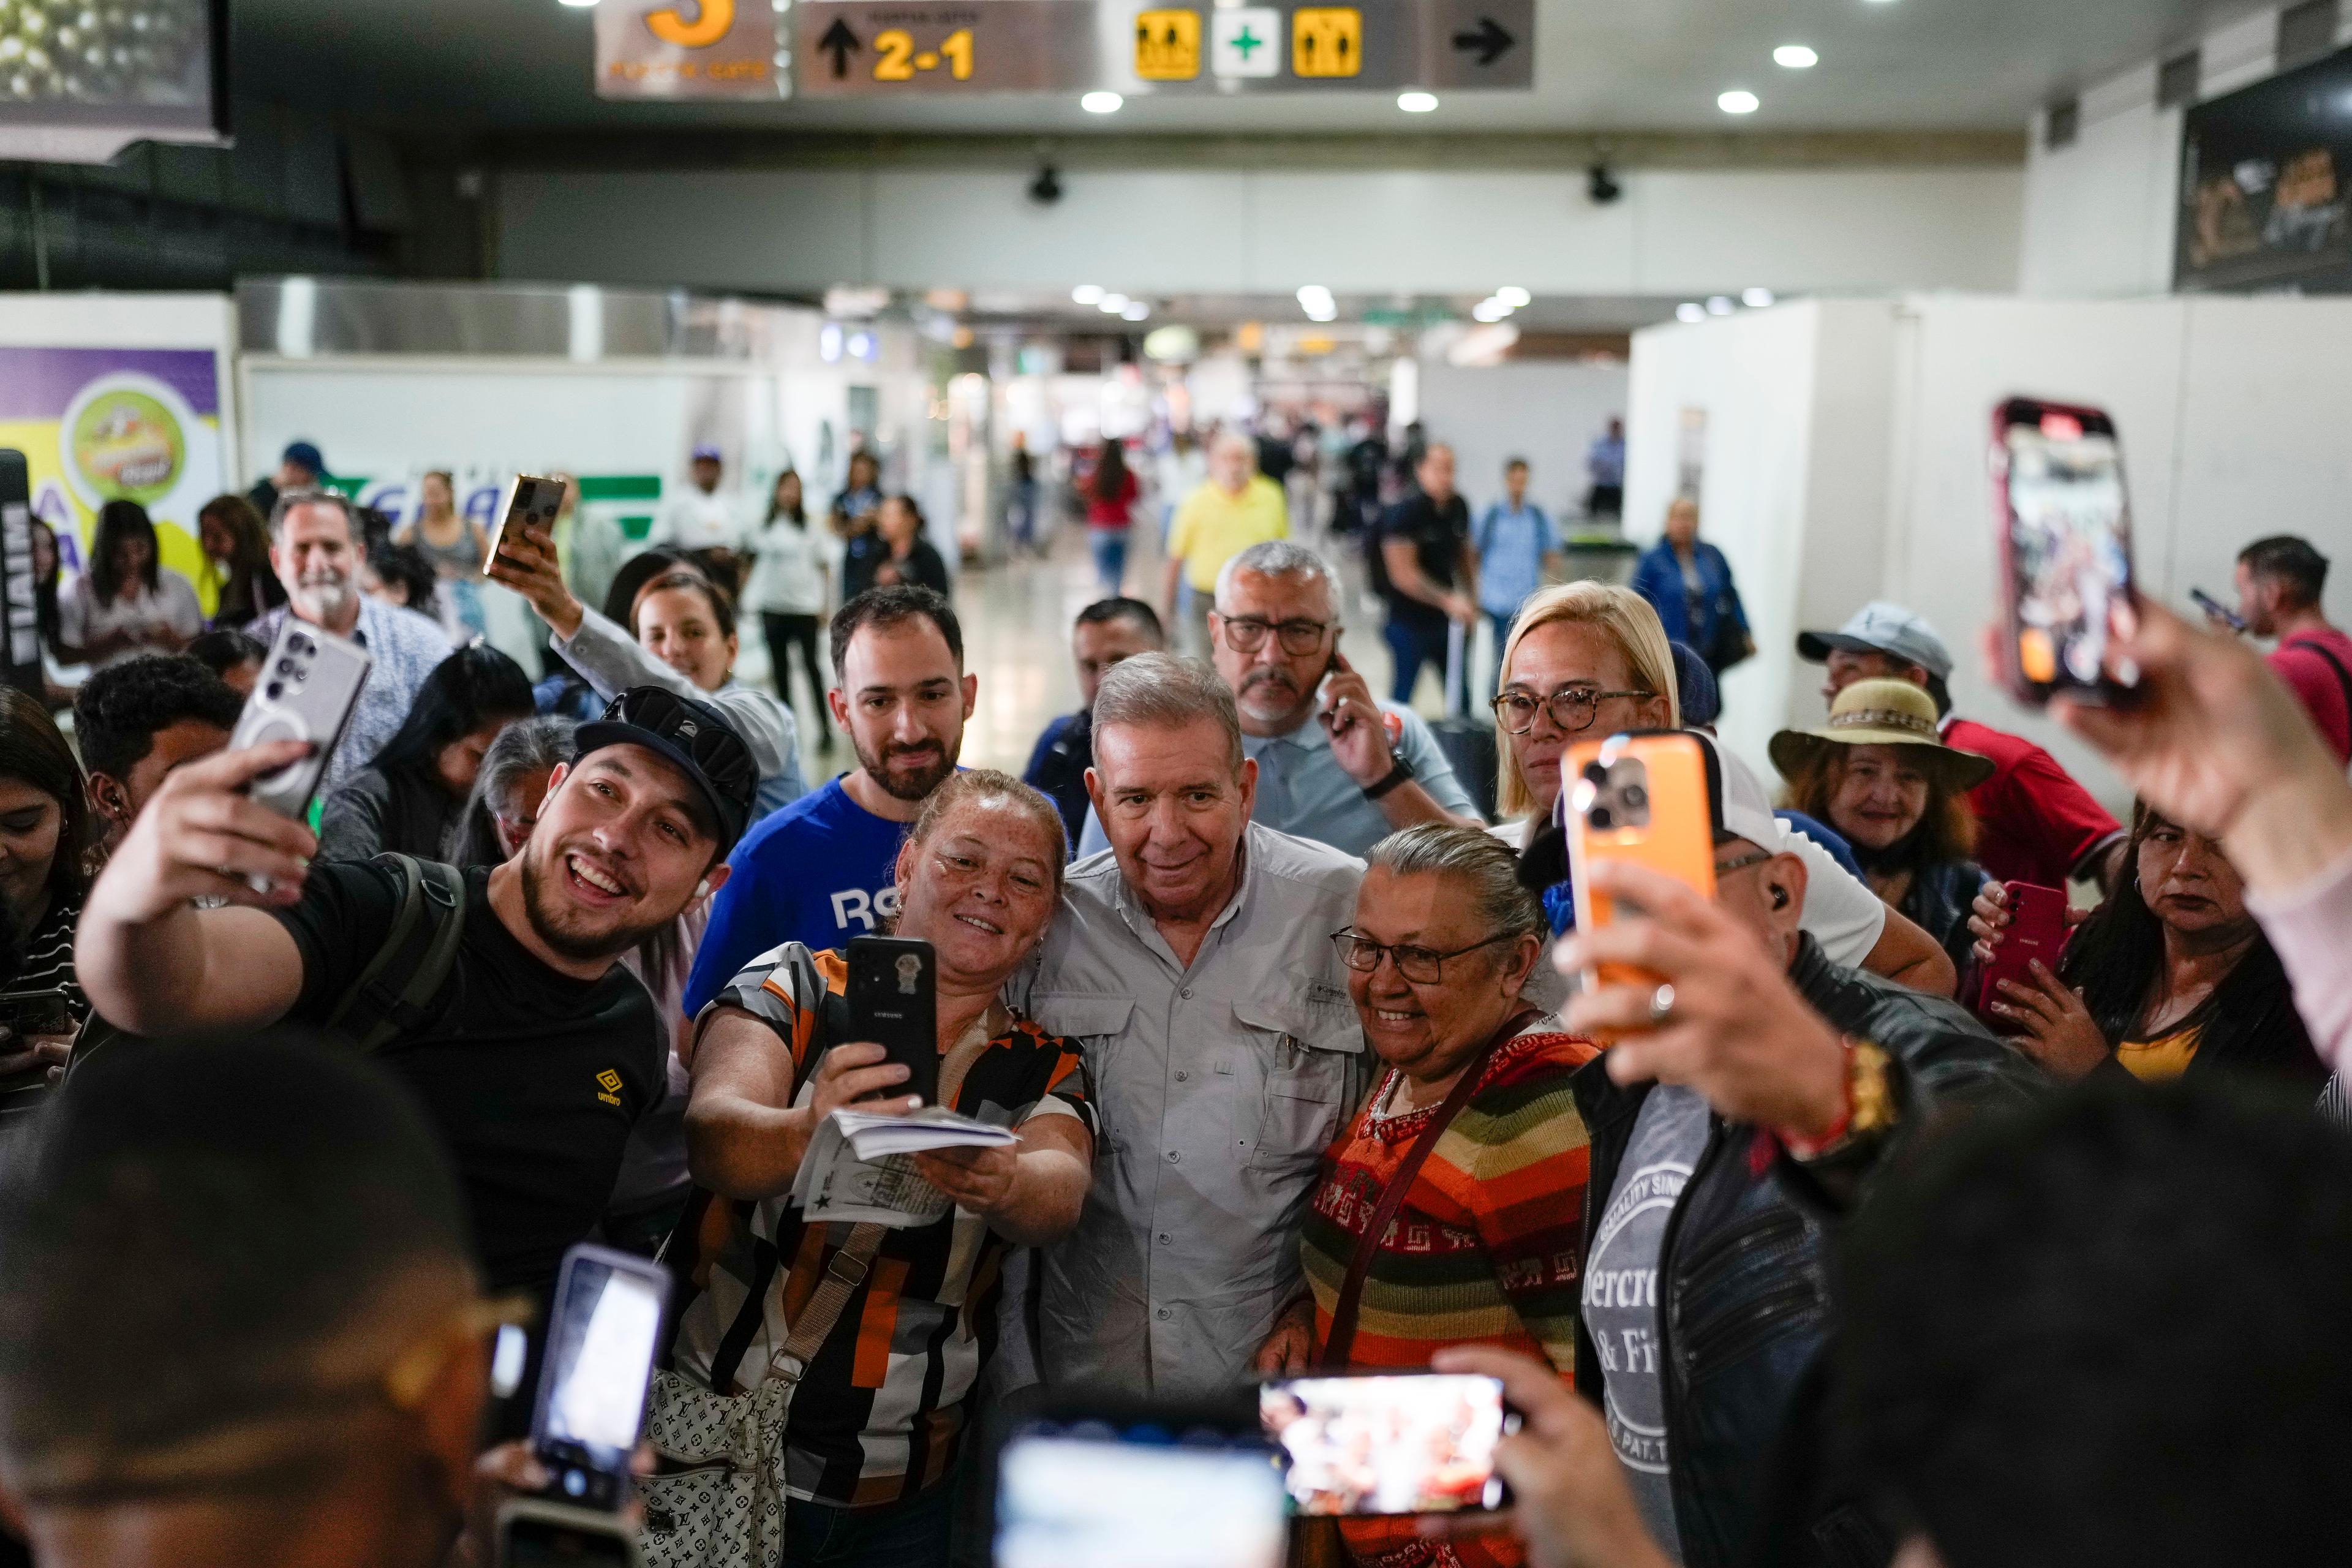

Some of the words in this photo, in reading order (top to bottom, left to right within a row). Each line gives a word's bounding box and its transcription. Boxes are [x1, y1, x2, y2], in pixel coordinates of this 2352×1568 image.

[873, 28, 973, 81] 2-1
[1322, 985, 1346, 997] Columbia
[598, 1092, 620, 1107] umbro
[1597, 1329, 1618, 1372] &
